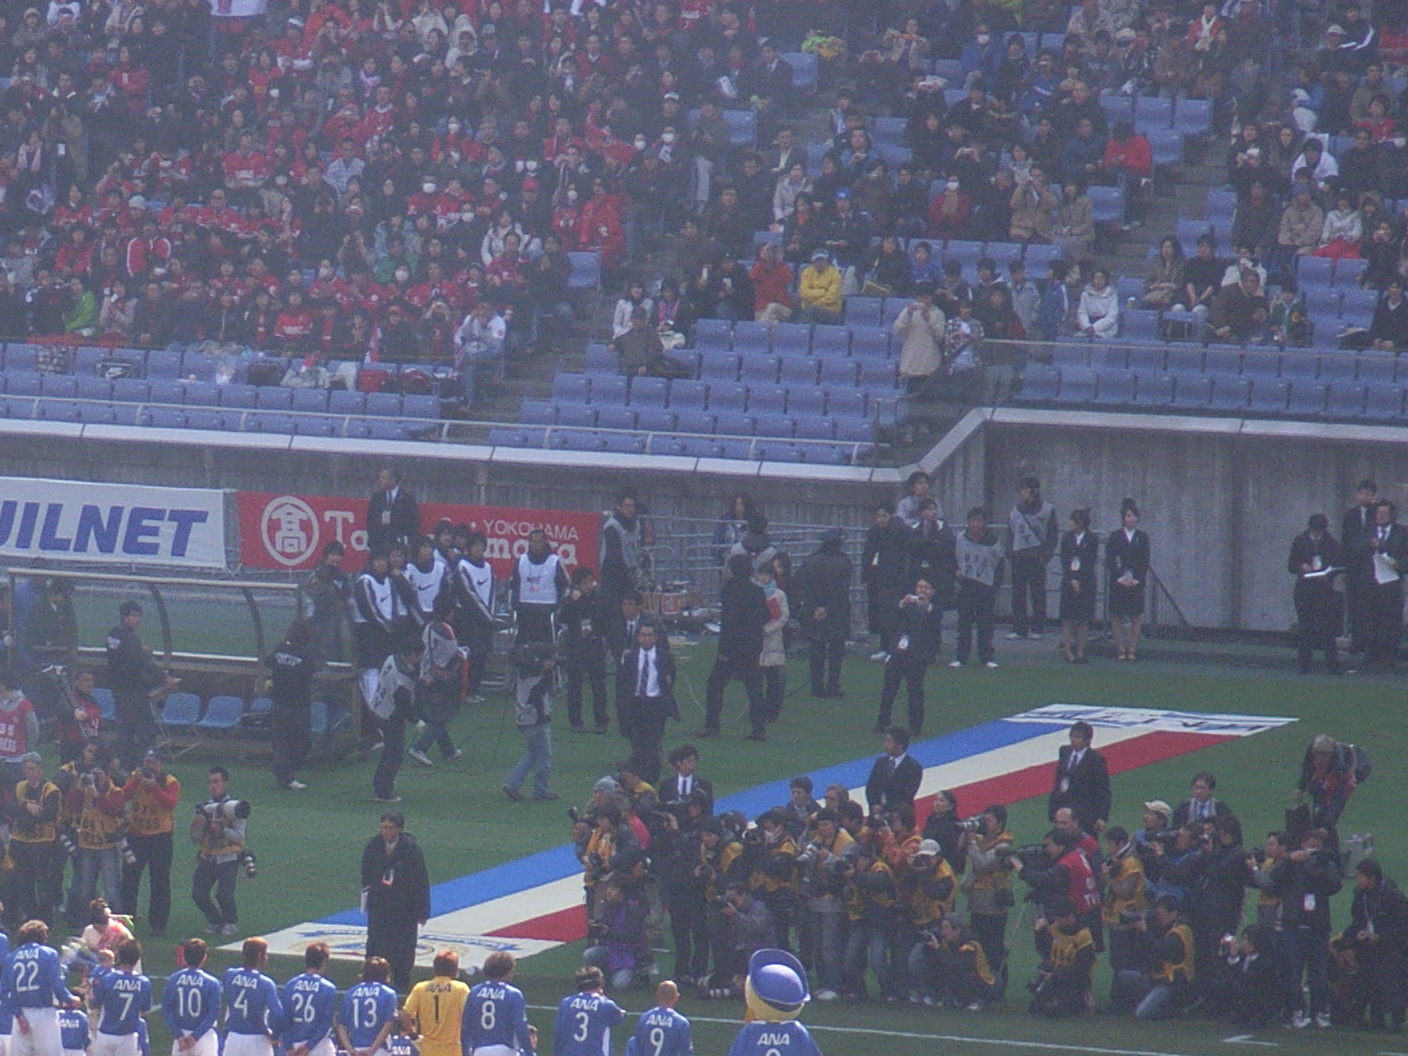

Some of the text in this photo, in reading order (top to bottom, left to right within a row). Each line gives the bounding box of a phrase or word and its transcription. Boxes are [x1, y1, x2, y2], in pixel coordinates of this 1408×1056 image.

[13, 947, 40, 961] ANA
[13, 960, 40, 992] 22
[176, 974, 204, 987] ANA
[231, 974, 257, 989] ANA
[113, 979, 142, 992] ANA
[294, 980, 321, 993] ANA
[352, 986, 380, 997] ANA
[425, 981, 452, 993] ANA
[477, 988, 506, 1000] ANA
[119, 993, 134, 1021] 7
[177, 987, 202, 1017] 10
[233, 989, 248, 1018] 4
[292, 993, 316, 1023] 26
[433, 995, 440, 1024] 1
[570, 998, 599, 1011] ANA
[353, 998, 377, 1028] 13
[481, 1001, 496, 1030] 8
[646, 1014, 673, 1027] ANA
[573, 1012, 589, 1042] 3
[650, 1027, 665, 1056] 9
[757, 1033, 790, 1046] ANA
